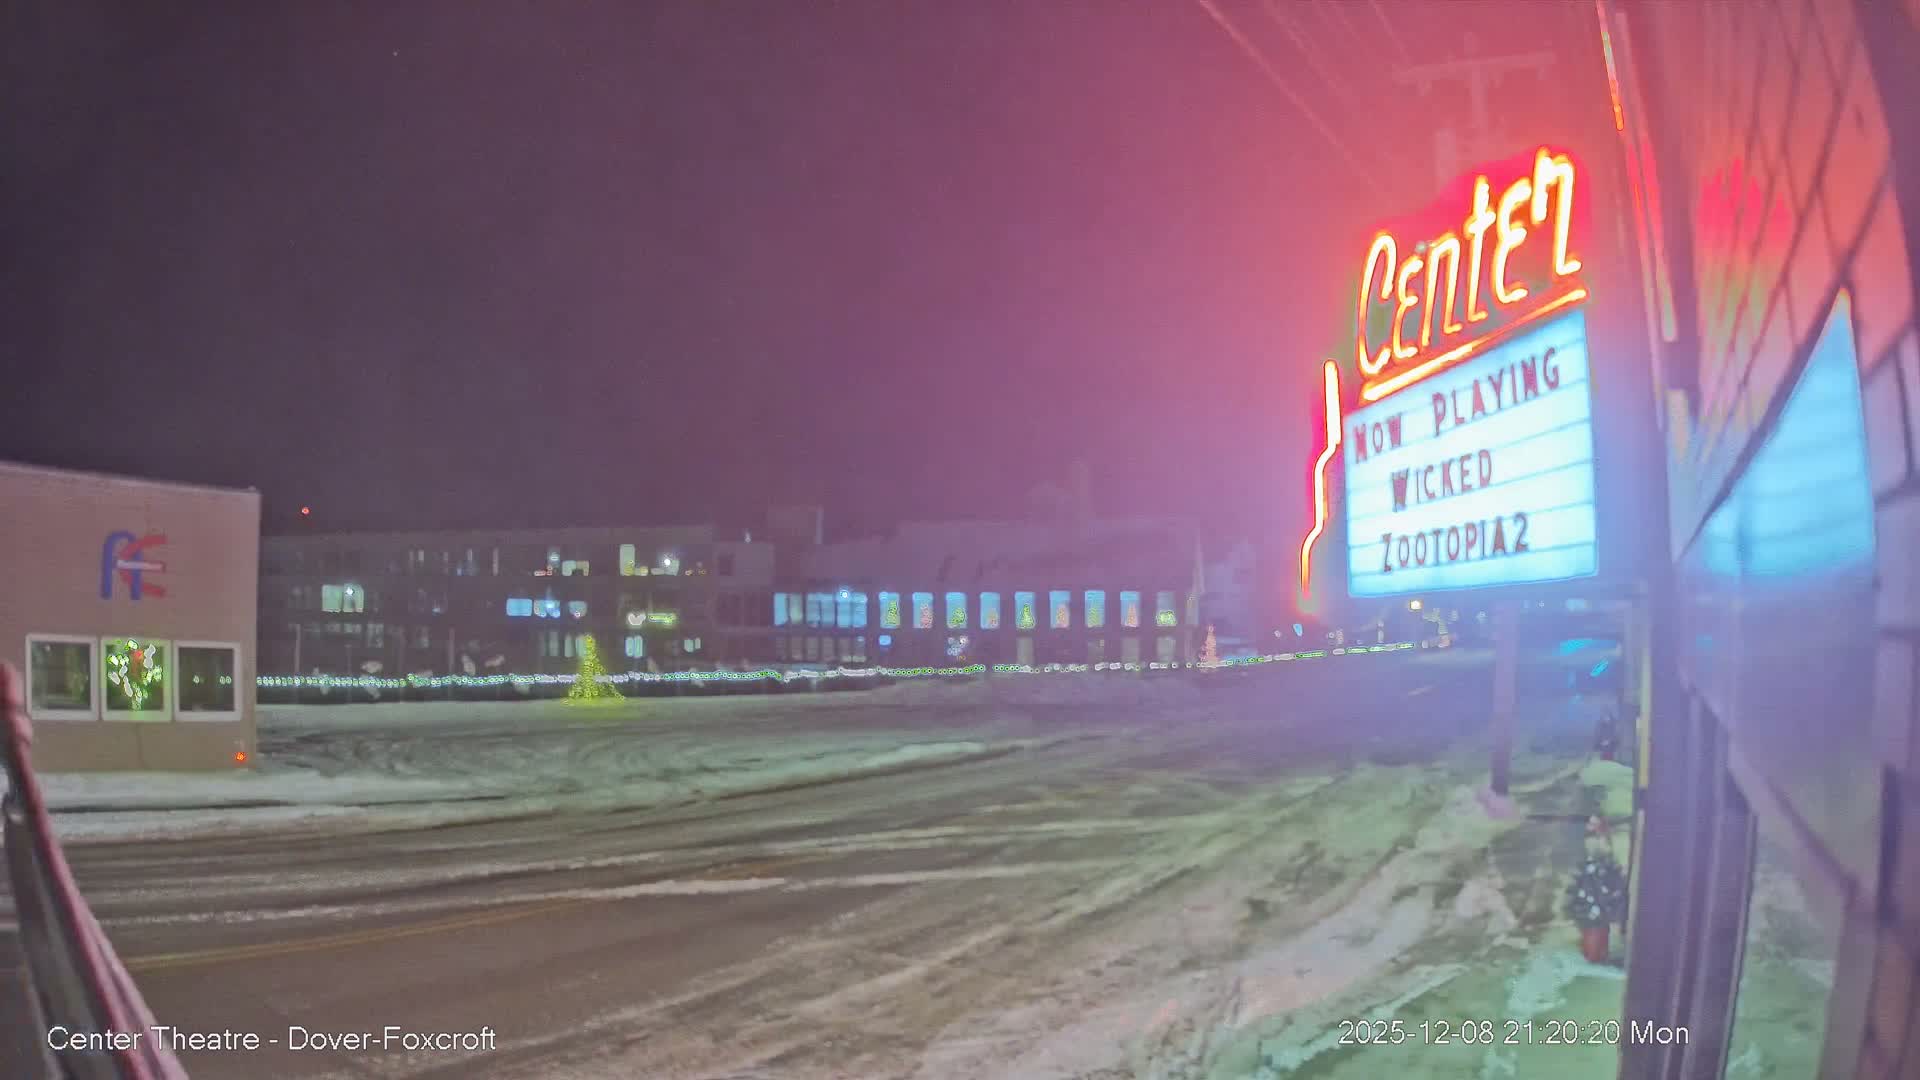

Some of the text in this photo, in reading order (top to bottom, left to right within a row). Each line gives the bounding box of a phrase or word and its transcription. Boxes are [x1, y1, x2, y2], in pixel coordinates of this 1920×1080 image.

[1353, 347, 1560, 464] NOW PLAYING
[1391, 449, 1493, 512] WICKED
[1381, 512, 1529, 573] ZOOTOPIA2
